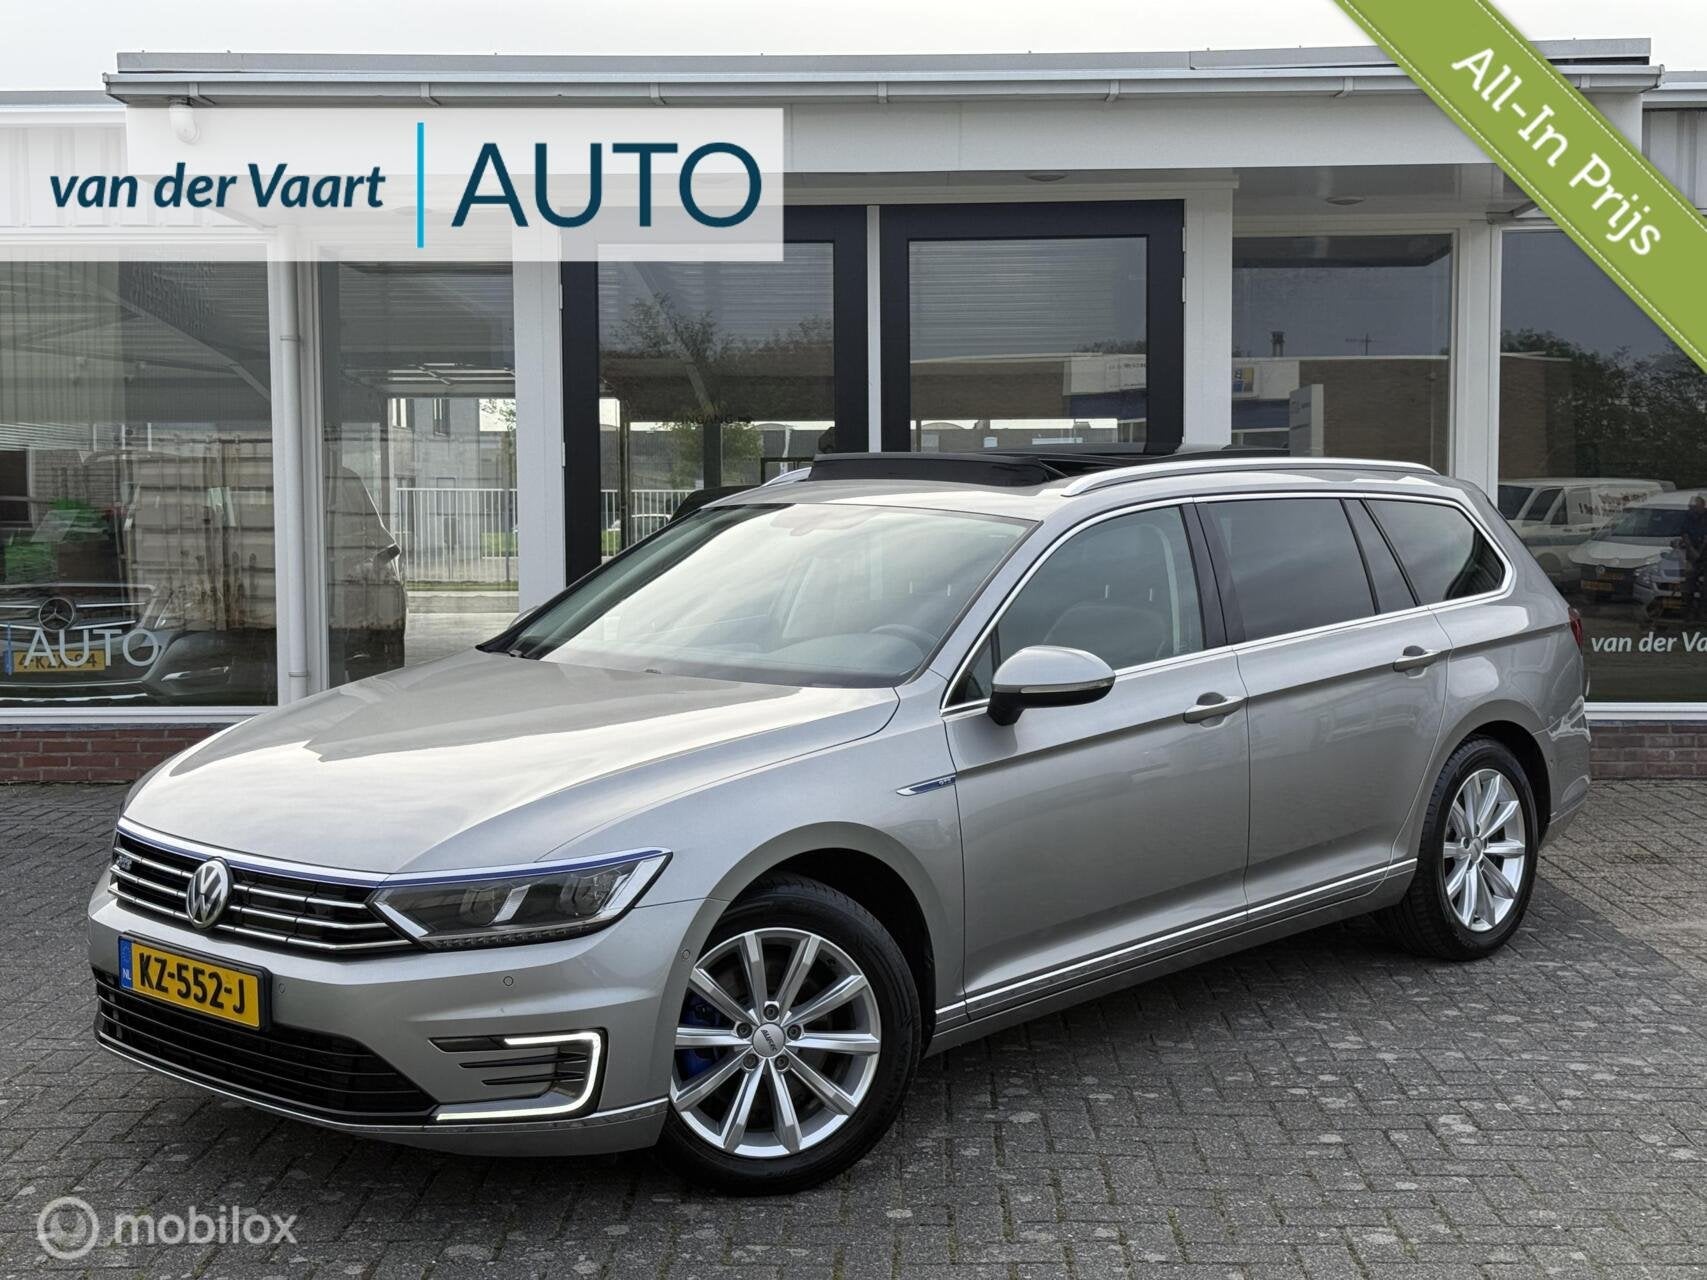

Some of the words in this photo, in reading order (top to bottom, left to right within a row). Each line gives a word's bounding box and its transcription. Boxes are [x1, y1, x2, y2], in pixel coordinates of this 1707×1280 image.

[23, 628, 159, 667] AUTO
[1591, 637, 1632, 652] van
[1638, 631, 1677, 652] der
[122, 967, 132, 981] NL
[138, 951, 245, 1014] KZ-552-J
